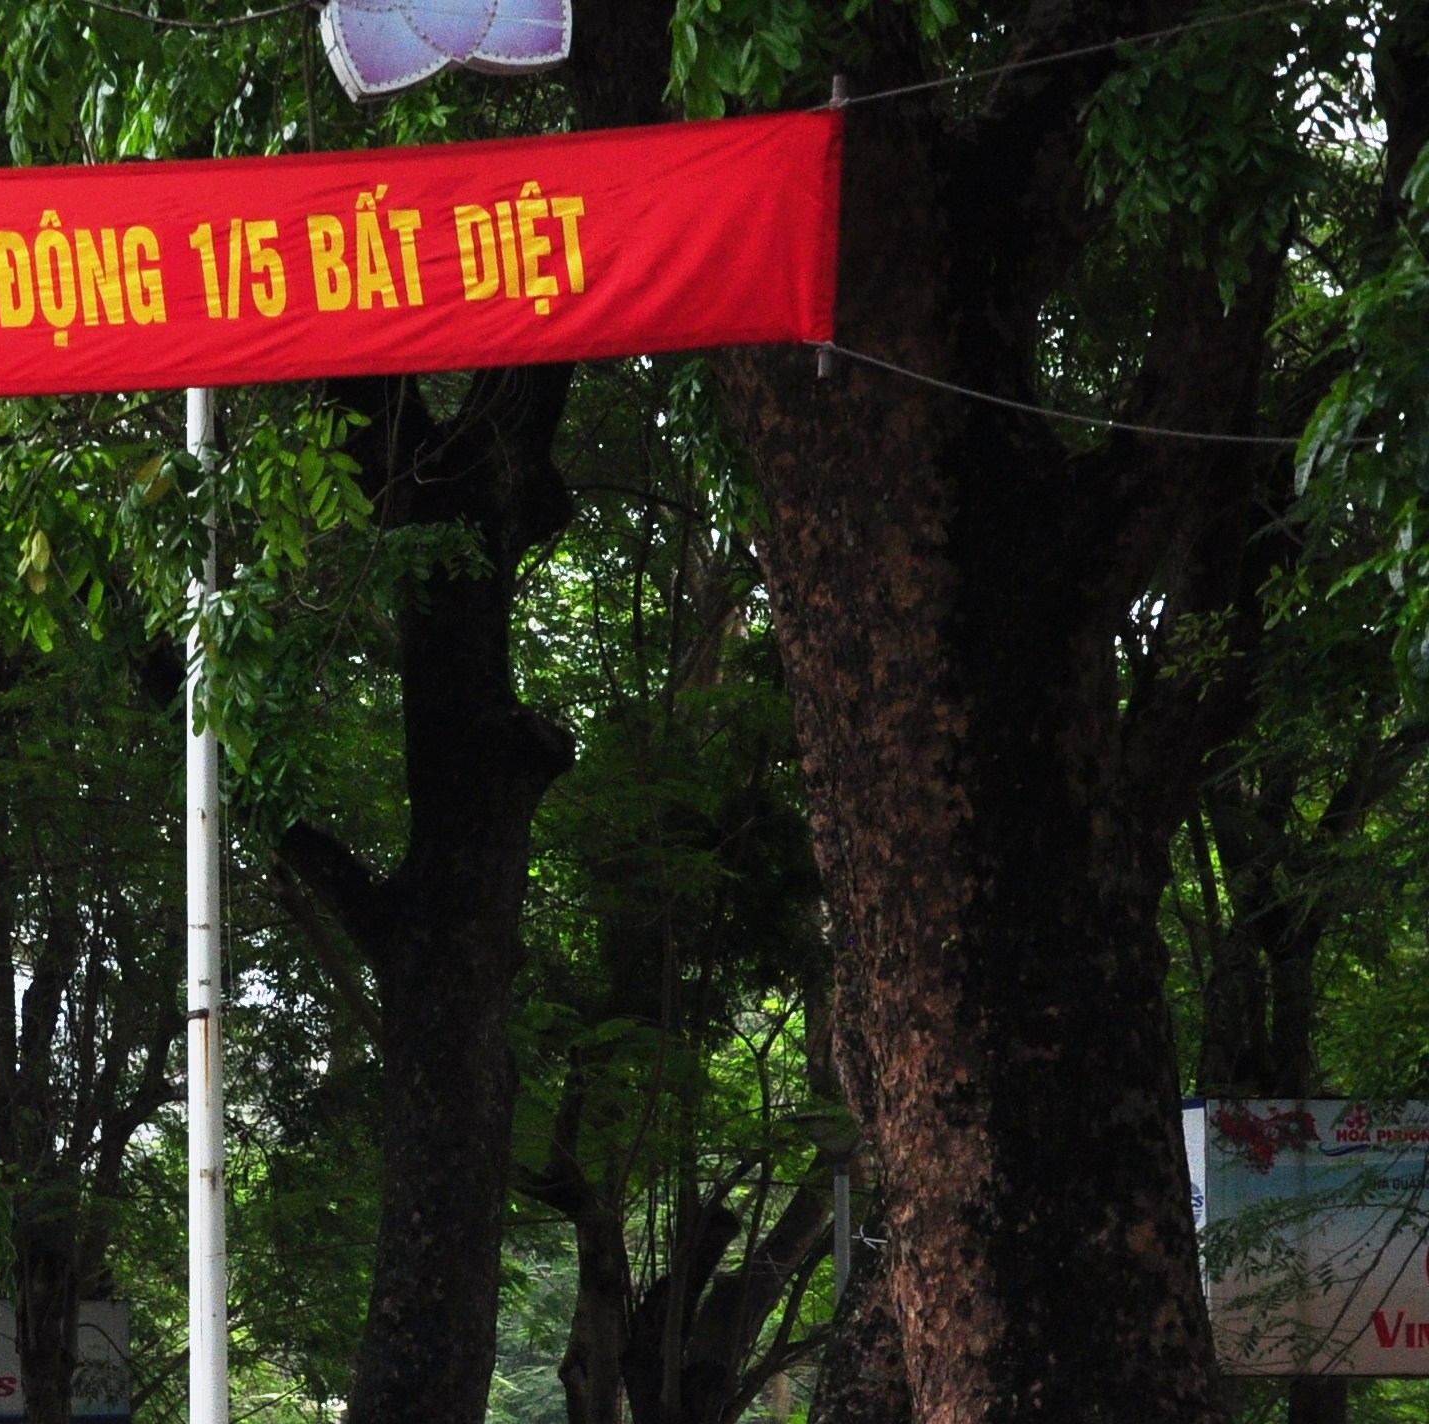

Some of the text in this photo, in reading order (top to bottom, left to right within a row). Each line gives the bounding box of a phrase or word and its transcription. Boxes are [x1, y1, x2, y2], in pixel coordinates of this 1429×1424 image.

[189, 218, 286, 320] 1/5
[307, 184, 423, 311] BẤT
[453, 180, 584, 315] DIỆT
[1336, 1129, 1371, 1142] HOA
